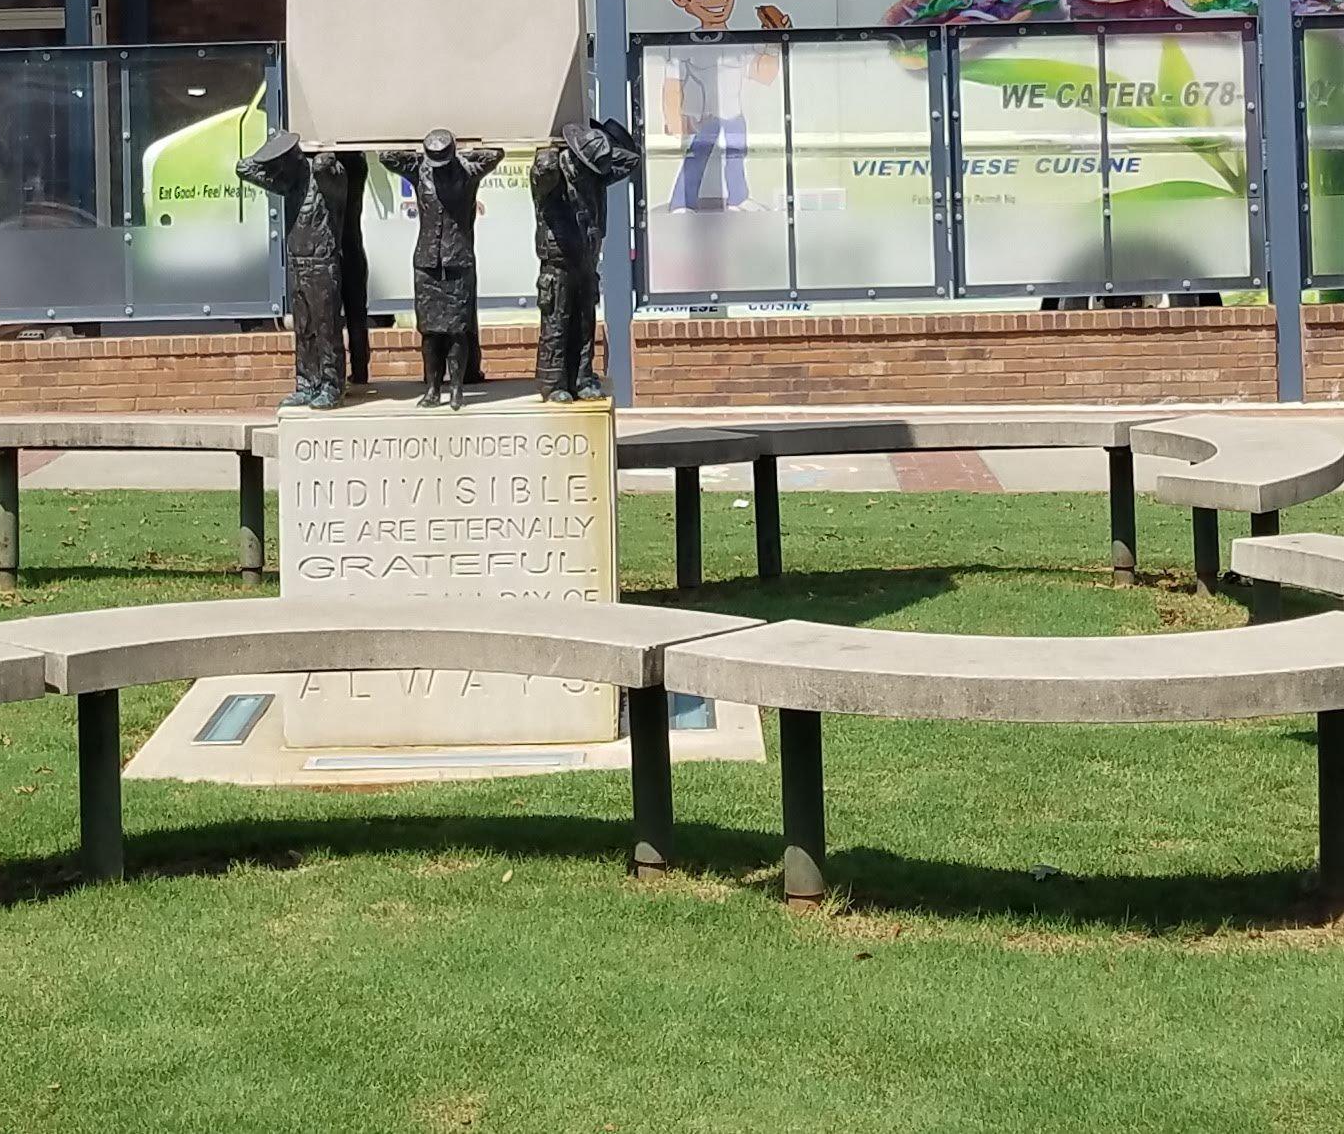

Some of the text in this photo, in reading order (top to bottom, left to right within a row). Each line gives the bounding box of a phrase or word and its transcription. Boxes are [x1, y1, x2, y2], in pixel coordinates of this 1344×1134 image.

[1002, 83, 1047, 109] WE
[1055, 81, 1156, 109] CATER
[852, 156, 1142, 177] VIETNESE CUISNE
[174, 185, 196, 200] Good
[202, 184, 223, 199] Feel
[223, 184, 257, 203] Heathy
[295, 433, 596, 462] ONE NATION, UNDER GOD,
[296, 474, 598, 508] INDIVISIBLE.
[297, 515, 595, 544] WE ARE ETERNALLY
[297, 551, 599, 580] GRATEFUL.
